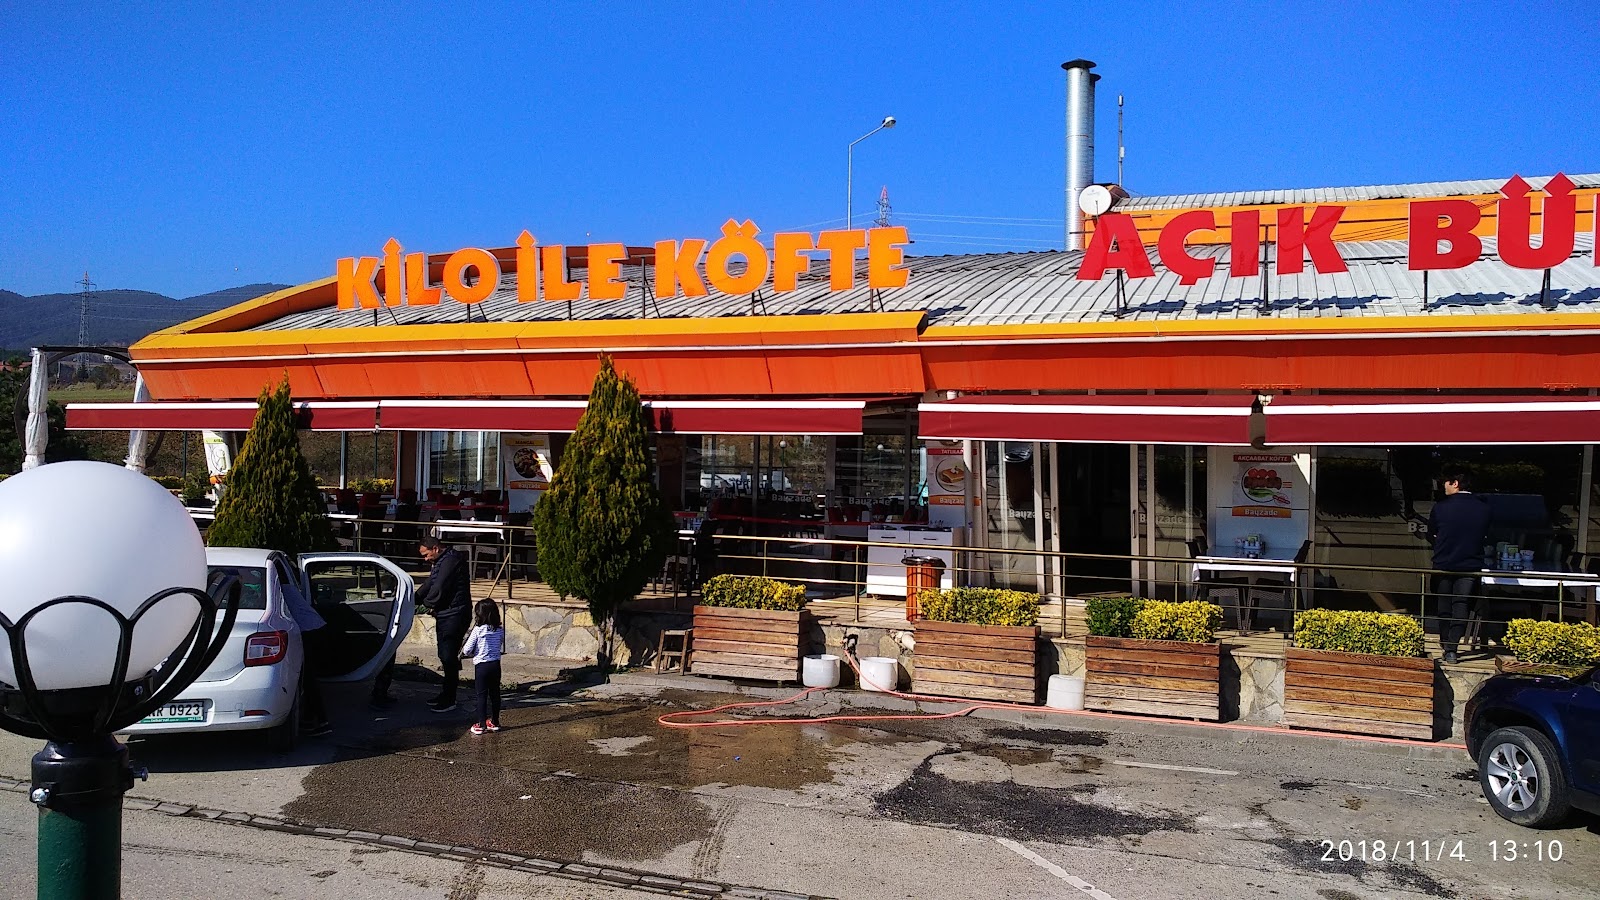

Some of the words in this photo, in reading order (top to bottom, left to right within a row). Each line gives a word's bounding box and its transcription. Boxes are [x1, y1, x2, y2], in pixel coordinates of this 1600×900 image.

[1076, 205, 1349, 286] AÇIK
[1408, 172, 1600, 271] BÜ
[337, 237, 500, 310] KİLO
[516, 229, 629, 303] İLE
[654, 218, 910, 297] KÖFTE
[771, 493, 812, 503] Bayzade
[848, 496, 891, 507] Bayzade
[939, 497, 964, 505] Bayzad
[1008, 508, 1051, 520] Bayze
[1244, 508, 1278, 516] Bayzade
[1139, 513, 1184, 525] Bzade
[1407, 521, 1428, 533] Ba
[169, 703, 200, 716] 0923
